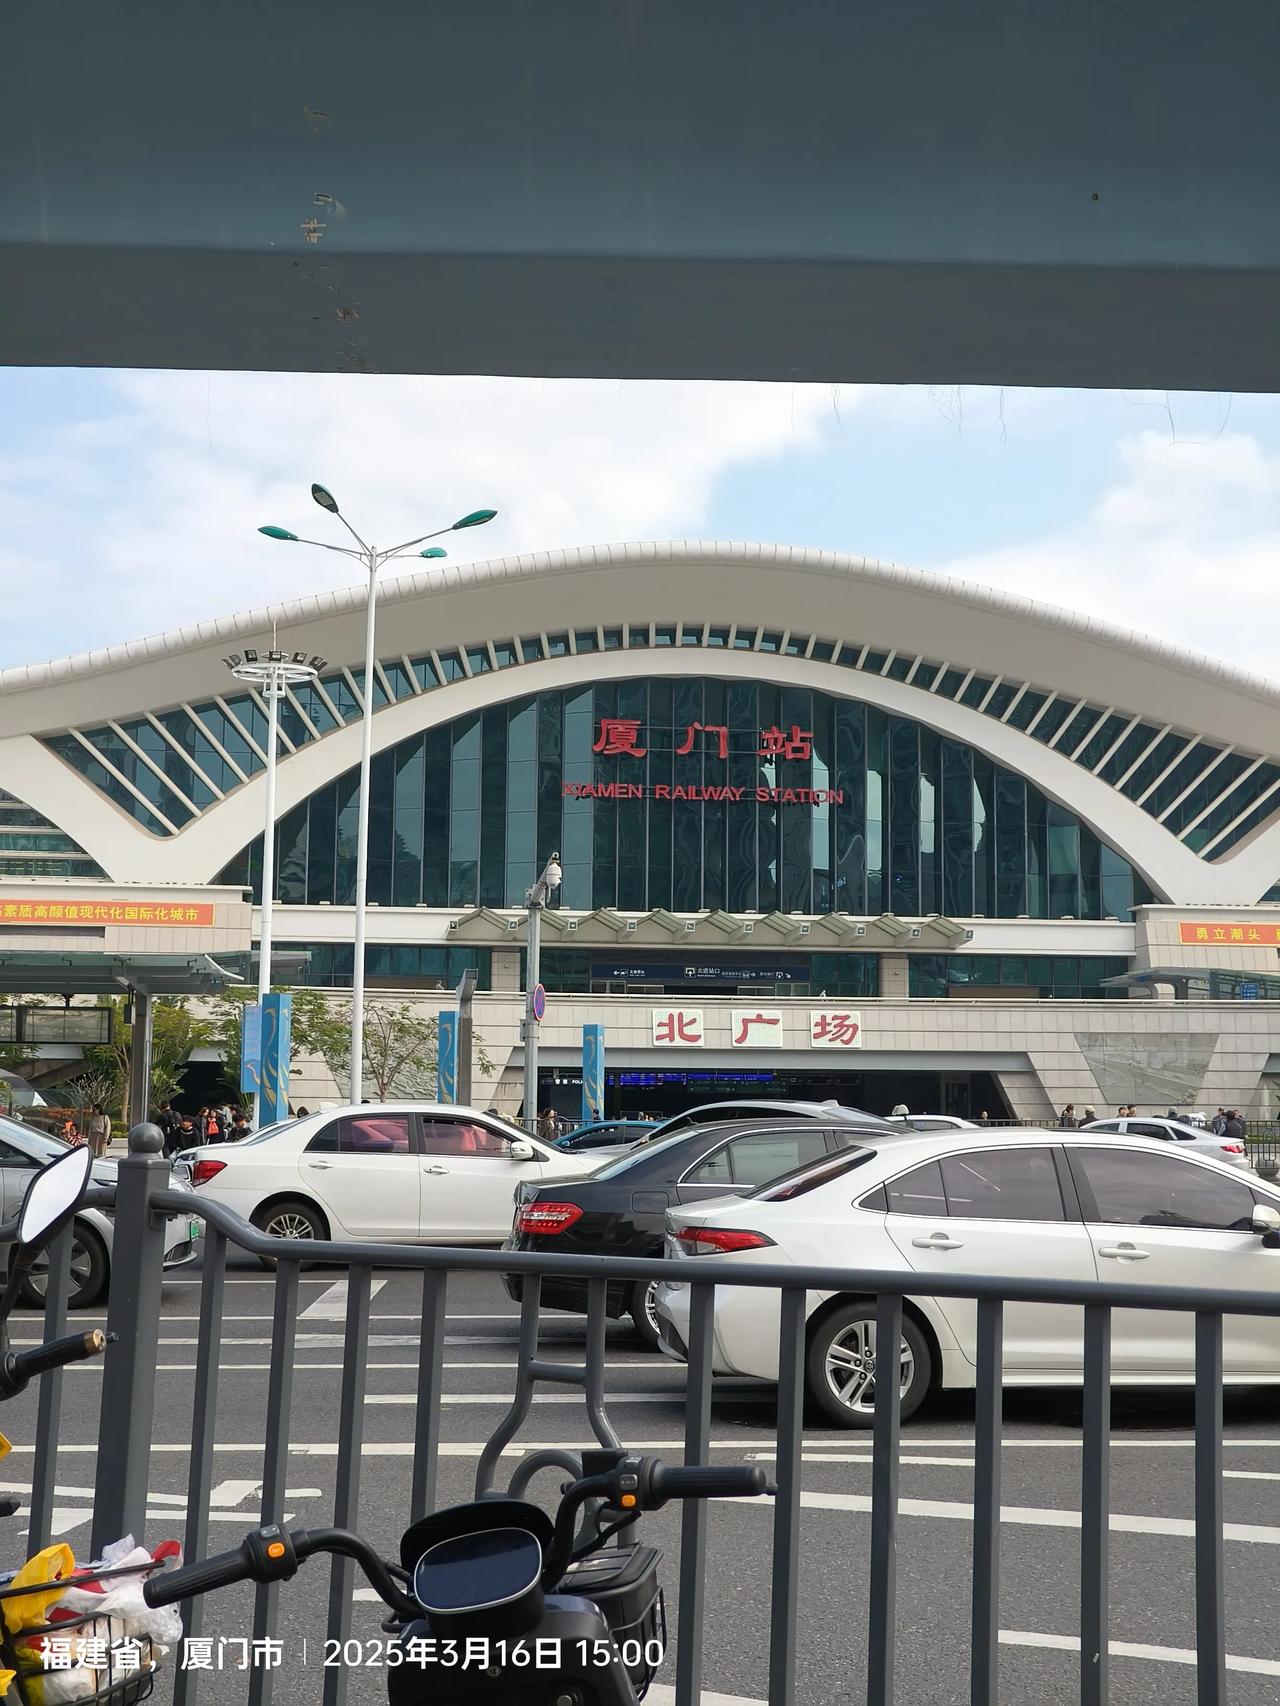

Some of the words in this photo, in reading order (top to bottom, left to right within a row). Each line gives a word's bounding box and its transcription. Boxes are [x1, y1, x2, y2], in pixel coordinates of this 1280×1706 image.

[593, 719, 814, 760] 厦门站
[561, 783, 643, 800] XIAMEN
[655, 785, 746, 801] RAILWAY
[755, 787, 844, 804] STATION
[1196, 927, 1261, 941] 勇立潮头
[655, 1011, 859, 1045] 北广场
